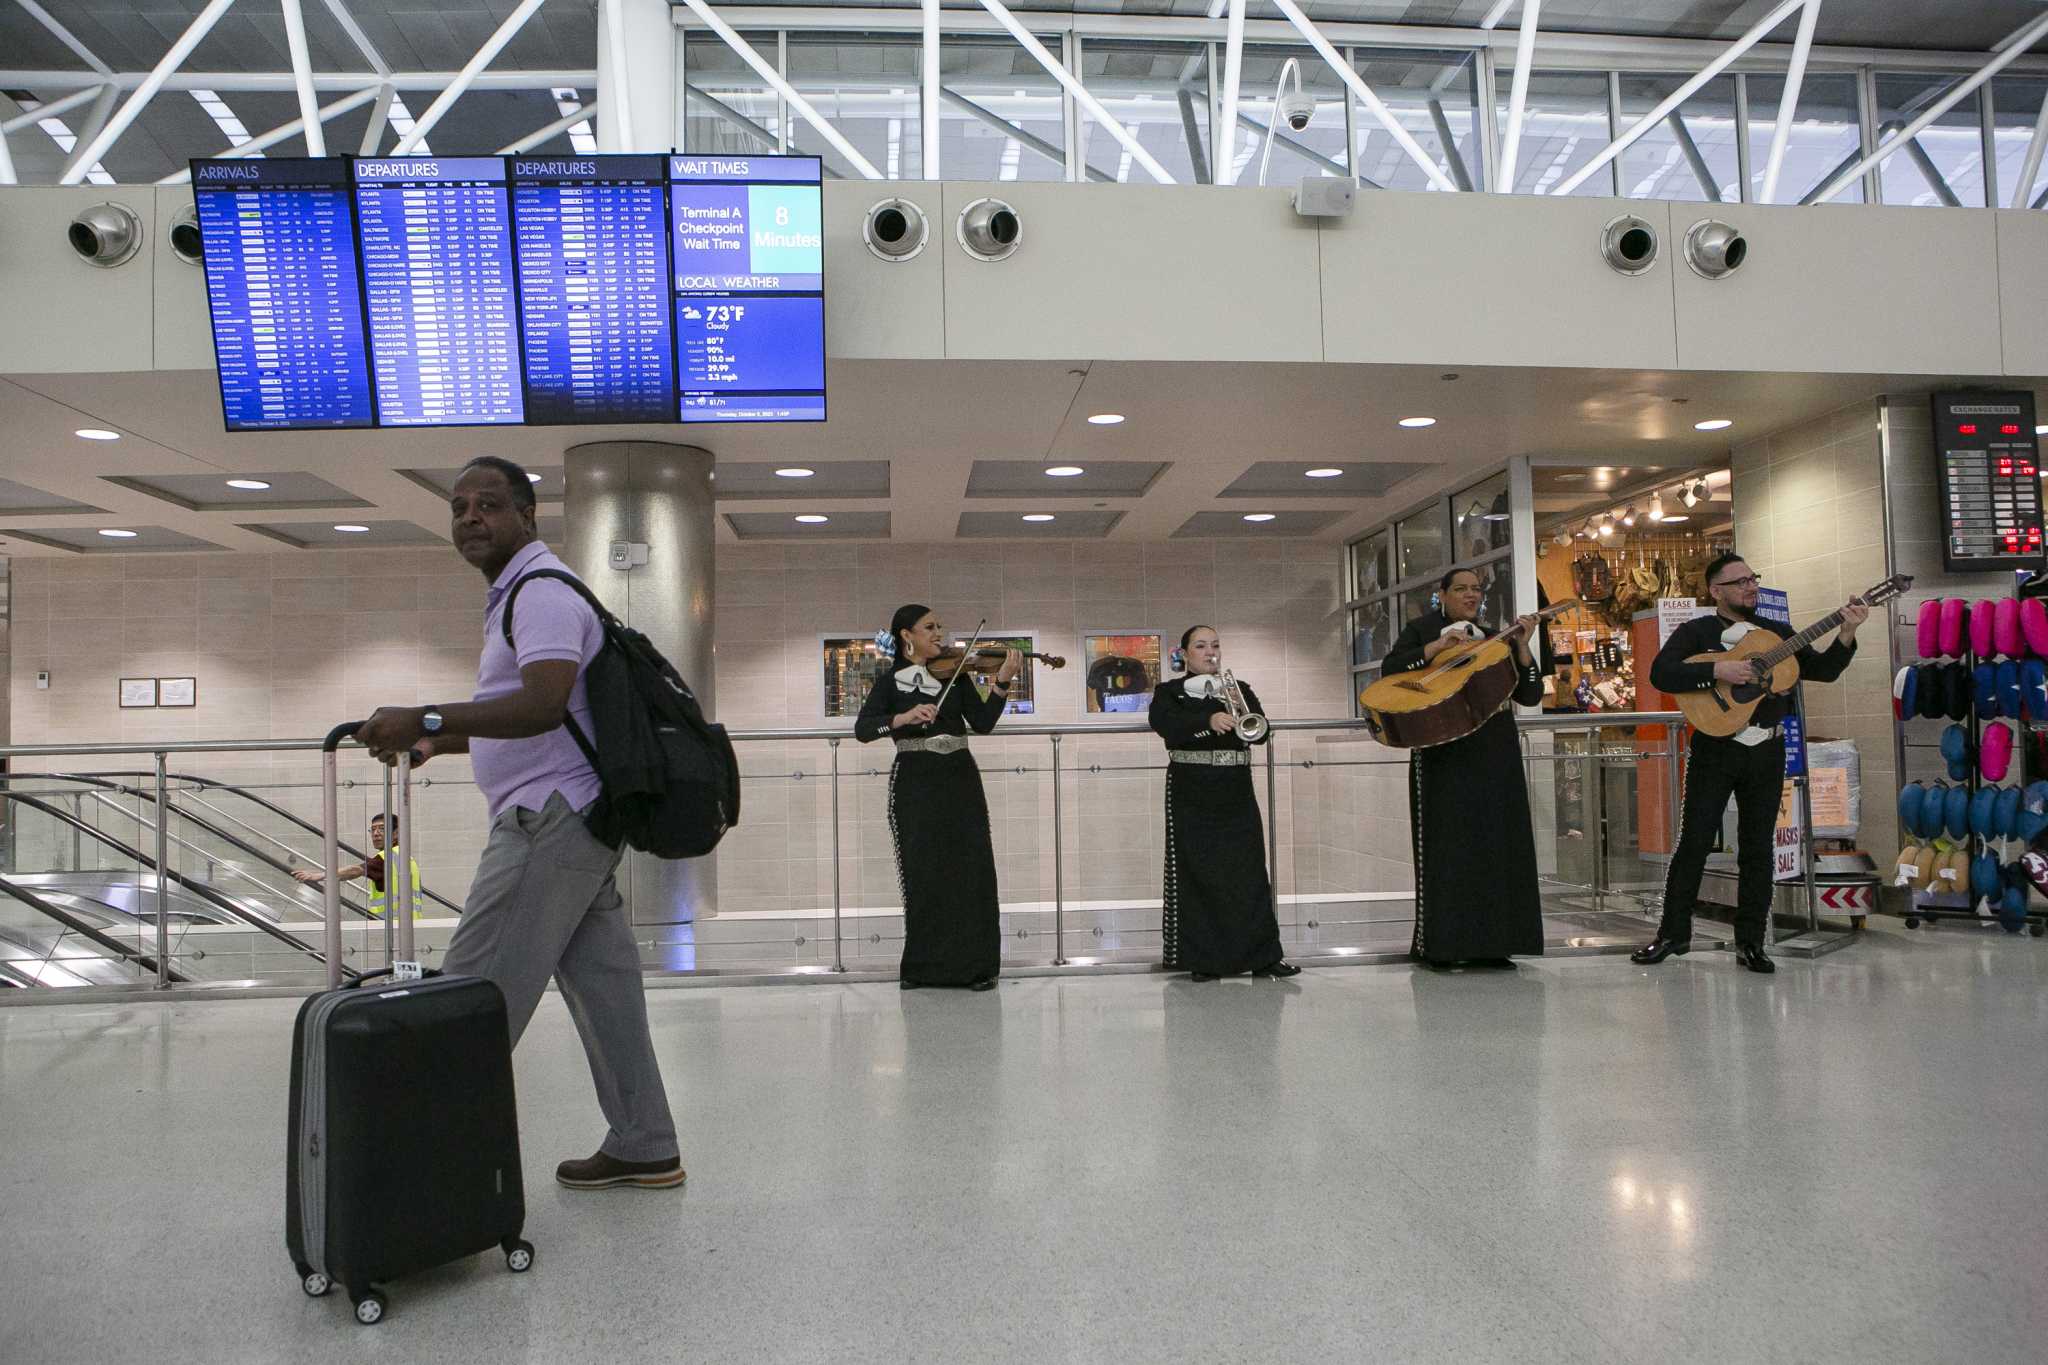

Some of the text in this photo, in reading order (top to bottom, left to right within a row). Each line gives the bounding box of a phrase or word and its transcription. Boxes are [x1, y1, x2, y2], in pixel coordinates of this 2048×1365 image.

[199, 166, 259, 178] ARRIVALS
[358, 164, 438, 177] DEPARTURES
[516, 162, 595, 175] DEPARTURES
[675, 162, 749, 174] WAIT TIMES
[681, 207, 742, 218] Terminal A
[775, 206, 788, 226] 8
[679, 223, 744, 236] Checkpoint
[683, 238, 740, 250] Wait Time
[754, 231, 820, 248] Minutes
[680, 277, 780, 288] LOCAL WEATHER
[707, 305, 744, 321] 73°F
[706, 322, 729, 331] Cloudy
[1776, 827, 1799, 848] MASKS
[1778, 852, 1794, 873] SALE
